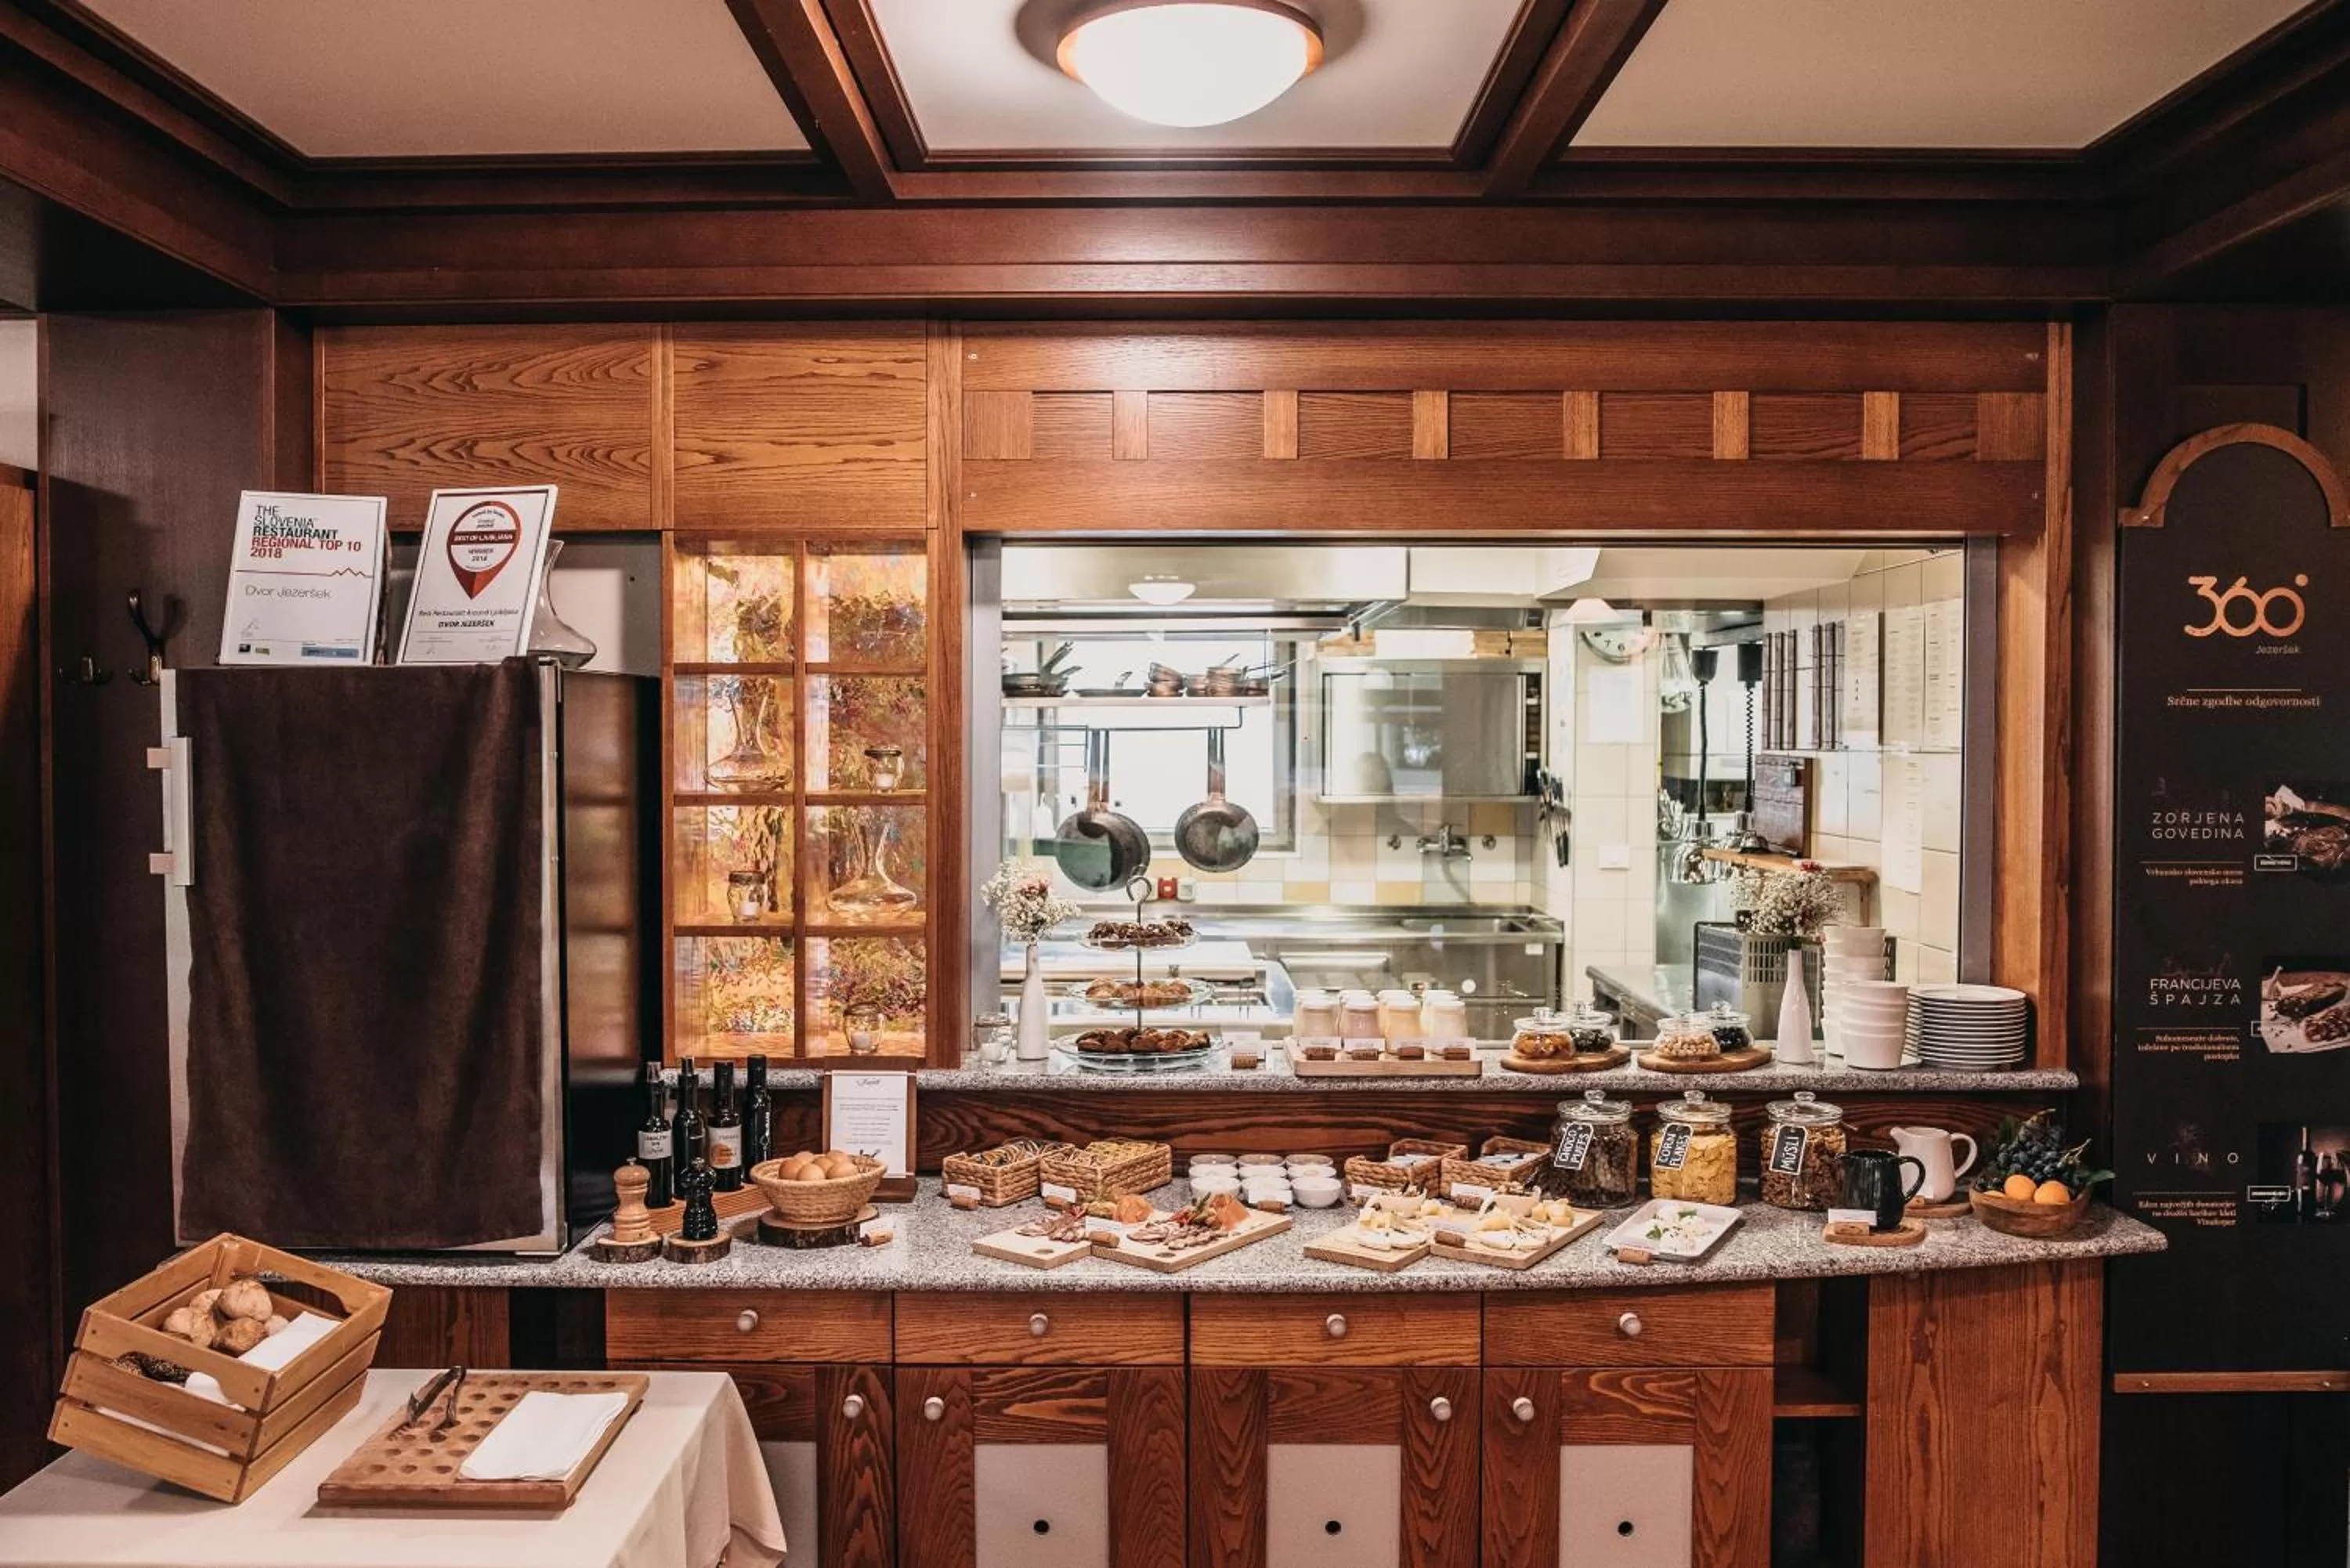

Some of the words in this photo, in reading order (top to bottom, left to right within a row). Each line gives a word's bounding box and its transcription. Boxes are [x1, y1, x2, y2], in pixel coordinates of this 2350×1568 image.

[257, 505, 280, 516] THE
[254, 515, 314, 528] SLOVENIA
[253, 526, 338, 539] RESTAURANT
[251, 537, 313, 549] REGIONAL
[320, 540, 343, 551] TOP
[347, 541, 362, 551] 10
[250, 547, 283, 558] 2018
[245, 585, 274, 596] Dvor
[2202, 695, 2243, 708] zgodbe
[2245, 695, 2321, 708] odgovornosti
[2153, 812, 2244, 824] ZORJENA
[2152, 828, 2244, 840] GOVEDINA
[2150, 978, 2241, 990] FRANCIJEVA
[2149, 991, 2241, 1005] ŠPAJZA
[1559, 1129, 1577, 1162] CHOCO
[1571, 1133, 1589, 1163] PUFFS
[1659, 1133, 1676, 1163] CORN
[1669, 1135, 1690, 1166] FLAKES
[2147, 1152, 2239, 1165] VINO
